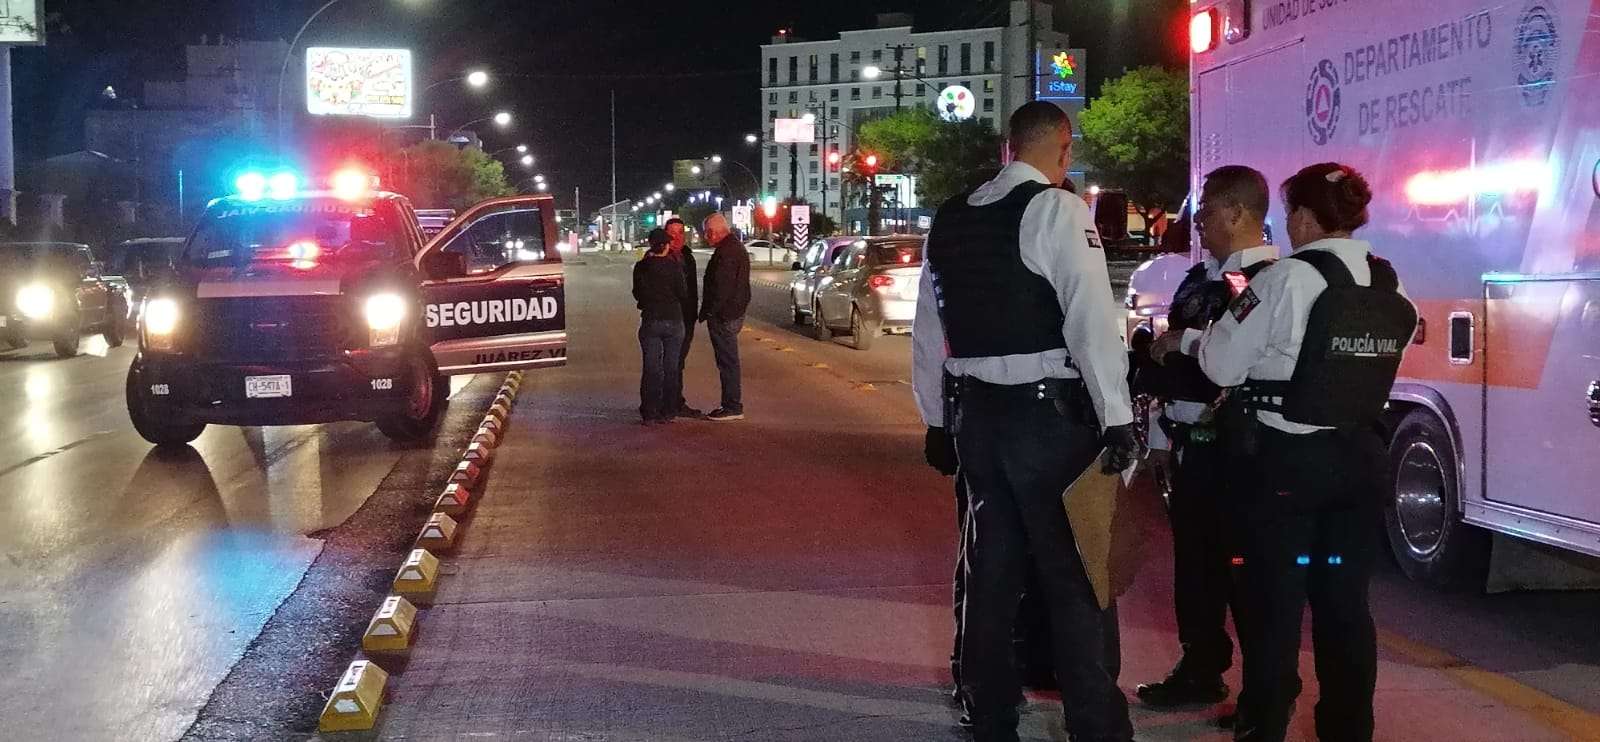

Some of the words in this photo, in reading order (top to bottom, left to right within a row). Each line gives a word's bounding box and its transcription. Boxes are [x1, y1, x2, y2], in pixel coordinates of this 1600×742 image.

[1344, 13, 1492, 85] DEPARTAMENTO
[1049, 81, 1077, 94] iStay
[1358, 98, 1380, 136] DE
[1386, 76, 1472, 130] RESCATE
[426, 296, 558, 328] SEGURIDAD
[1331, 332, 1375, 353] POLICÍA
[1377, 338, 1398, 353] VIAL
[370, 378, 392, 390] 1028
